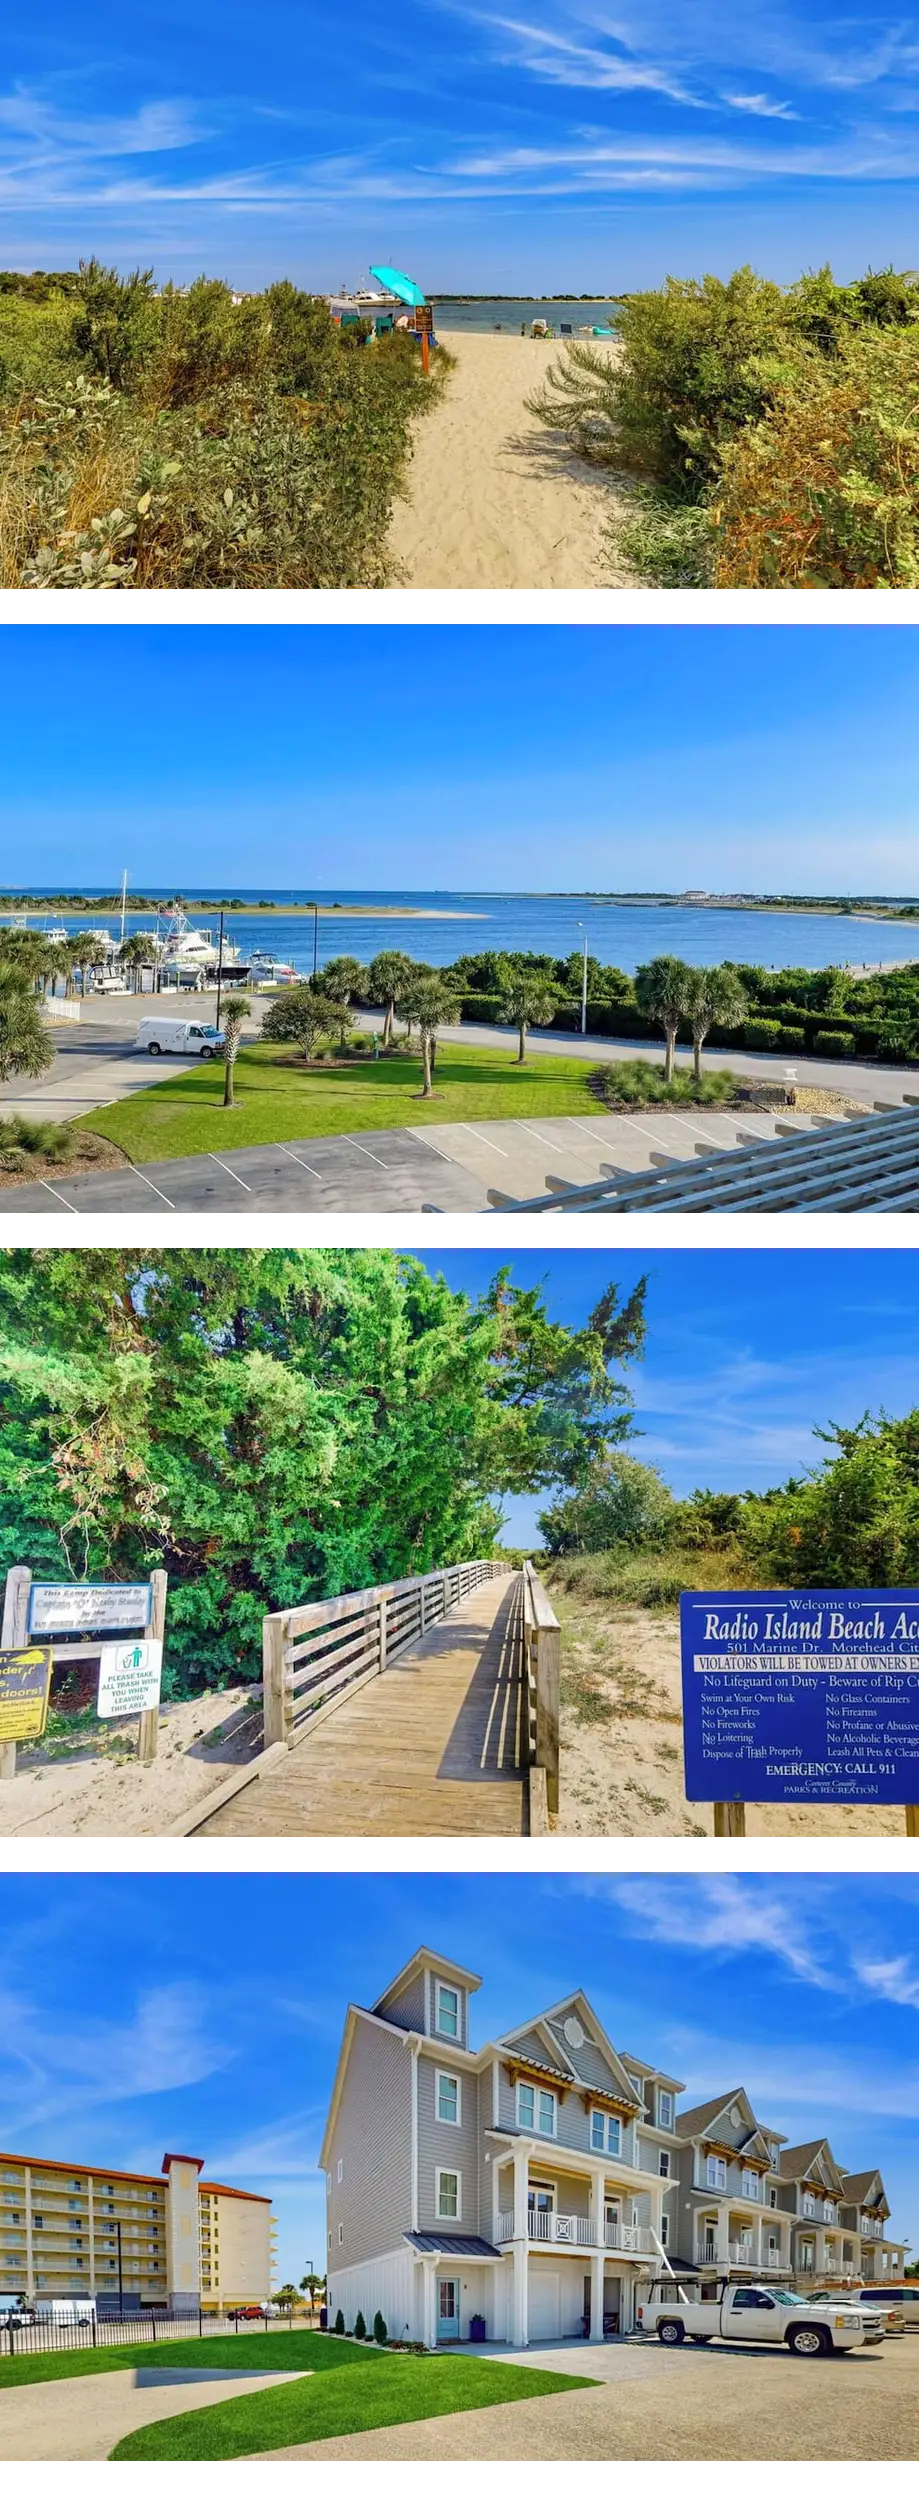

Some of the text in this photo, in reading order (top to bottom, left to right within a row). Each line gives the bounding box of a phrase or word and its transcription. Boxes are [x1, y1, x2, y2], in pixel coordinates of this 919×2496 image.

[789, 1599, 861, 1610] Welcome to
[703, 1611, 919, 1640] Radio Island Beach Ac
[727, 1642, 747, 1653] 501
[753, 1642, 798, 1653] Marine
[802, 1642, 824, 1653] Dr.
[832, 1641, 894, 1653] Morehead
[699, 1656, 758, 1670] VIOLATORS
[760, 1656, 786, 1670] WILL
[788, 1656, 801, 1670] BE
[803, 1656, 843, 1670] TOWED
[845, 1656, 858, 1670] AT
[860, 1656, 907, 1670] OWNERS
[108, 1674, 135, 1682] PLEASE
[703, 1675, 721, 1687] No
[724, 1675, 772, 1690] Lifeguard
[775, 1678, 788, 1687] on
[792, 1675, 818, 1690] Duty
[829, 1675, 868, 1687] Beware
[870, 1675, 883, 1687] of
[884, 1675, 904, 1691] Rip
[117, 1681, 139, 1689] TRASH
[115, 1695, 144, 1704] LEAVING
[700, 1693, 795, 1703] Swim at Your Own Risk
[825, 1694, 911, 1704] No Glass Containers
[129, 1701, 147, 1709] AREA
[702, 1706, 760, 1718] No Open Fires
[826, 1707, 878, 1717] No Firearms
[702, 1720, 756, 1729] No Fireworks
[826, 1720, 841, 1730] No
[842, 1720, 874, 1730] Profane
[886, 1721, 919, 1731] Abusive
[702, 1733, 754, 1744] No Loitering
[826, 1734, 919, 1746] No Alcoholic Beverage
[703, 1749, 733, 1760] Dispose
[735, 1746, 745, 1758] of
[769, 1746, 803, 1758] Properly
[827, 1747, 919, 1758] Leash All Pets & Clean
[765, 1763, 896, 1776] EMERGENCY: CALL 911
[784, 1786, 810, 1794] PARKS
[820, 1785, 879, 1794] RECREATION
